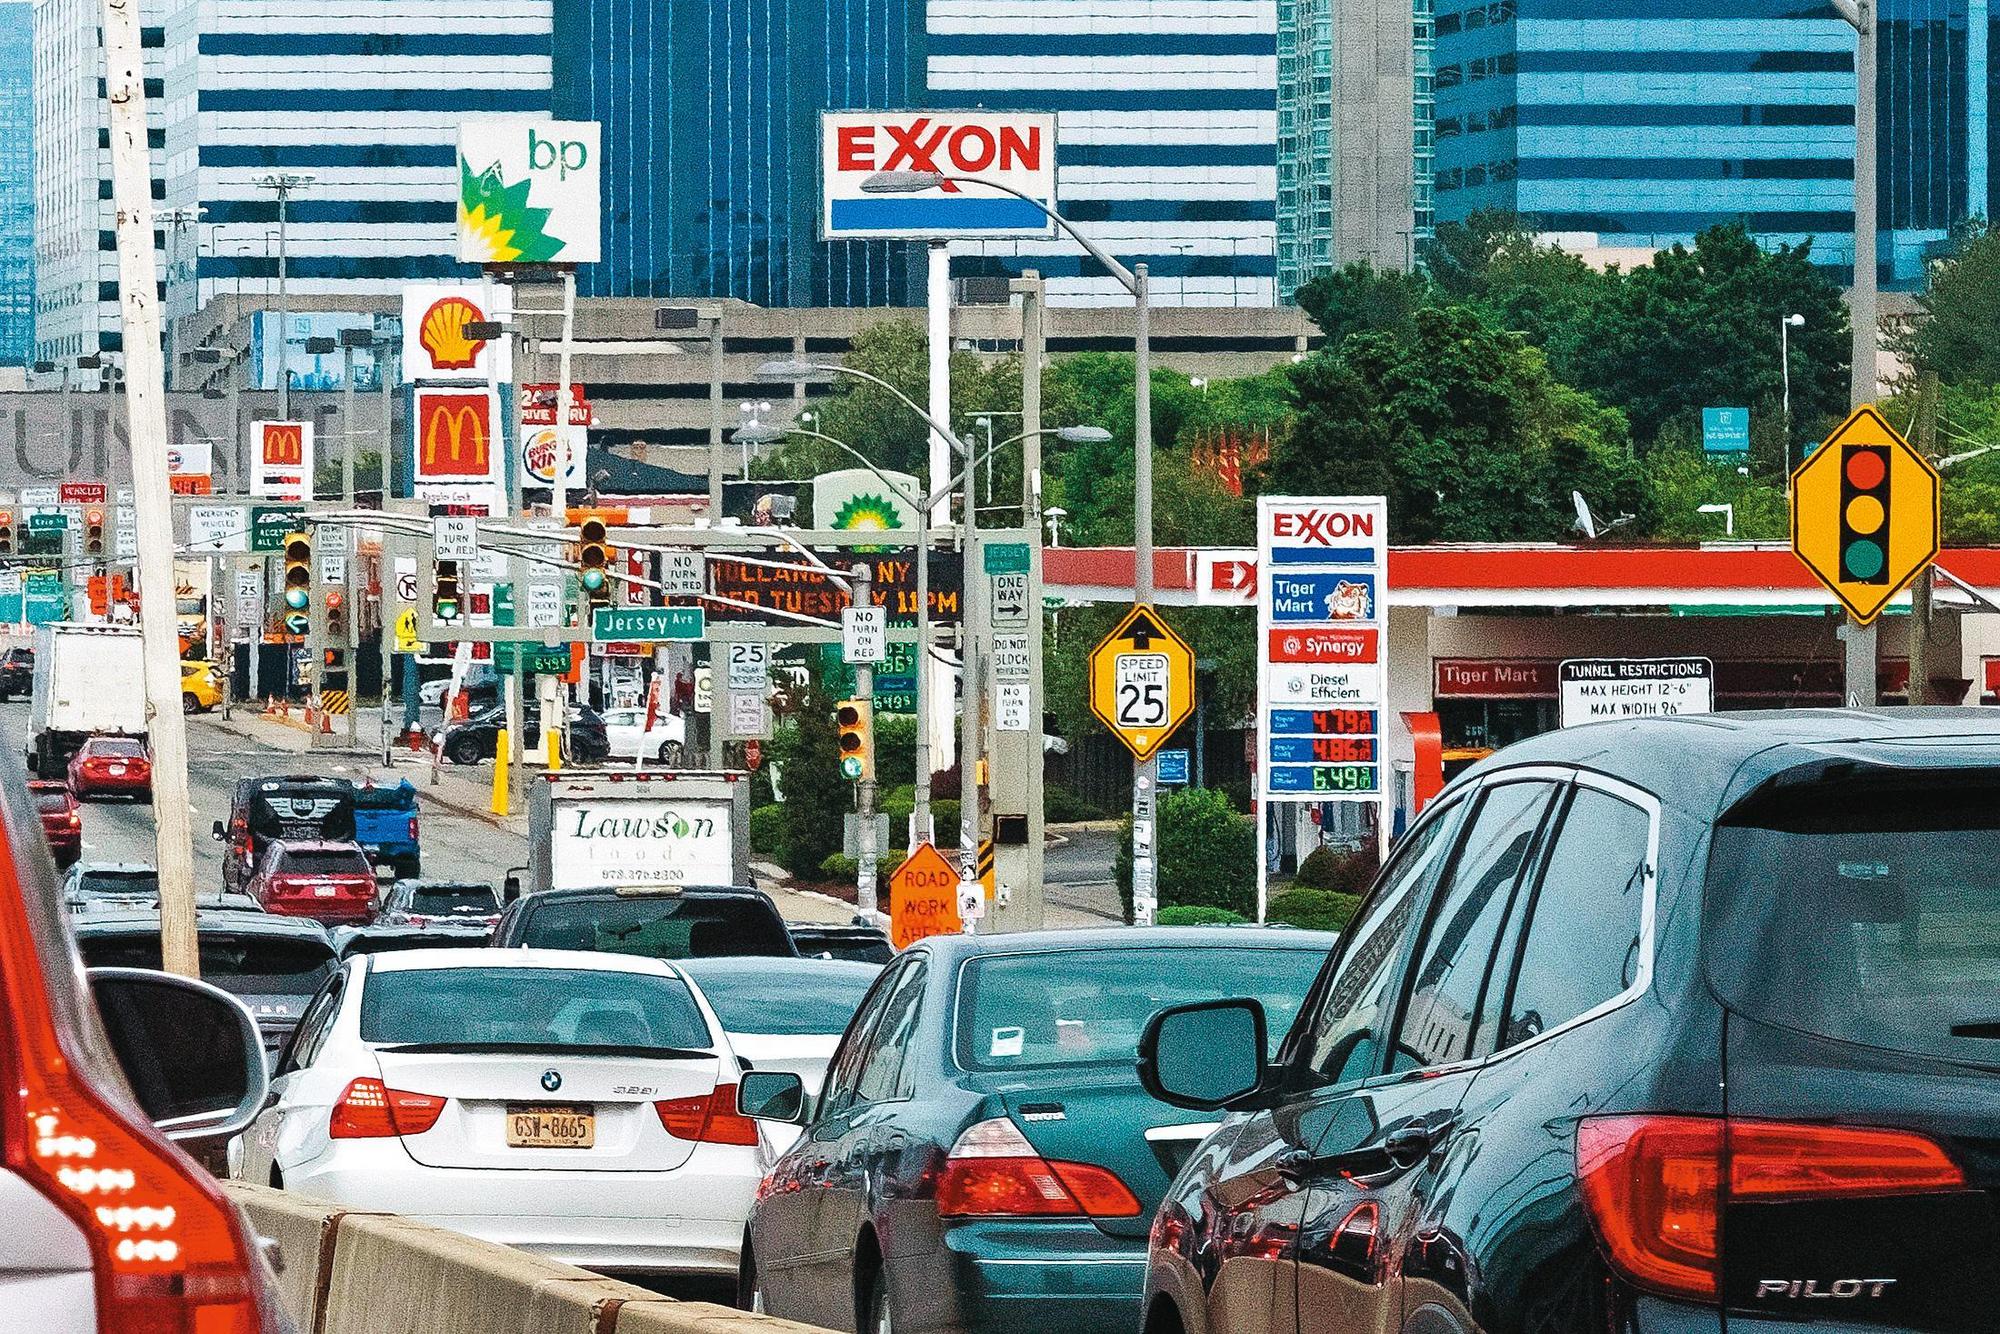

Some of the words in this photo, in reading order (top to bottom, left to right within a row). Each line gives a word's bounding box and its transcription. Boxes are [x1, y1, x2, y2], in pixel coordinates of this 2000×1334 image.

[528, 128, 588, 182] bp
[837, 118, 1041, 193] EXXON
[448, 522, 464, 531] NO
[1273, 509, 1374, 546] EXXON
[443, 535, 470, 544] TURN
[437, 546, 451, 555] ON
[455, 546, 475, 555] RED
[673, 557, 692, 567] NO
[671, 569, 697, 579] TURN
[877, 561, 911, 584] NY
[664, 581, 679, 590] ON
[682, 581, 702, 590] RED
[997, 577, 1024, 588] ONE
[1275, 580, 1316, 597] Tiger
[241, 585, 258, 596] 25
[997, 590, 1024, 601] WAY
[770, 590, 887, 614] TUESDY
[1275, 599, 1314, 613] Mart
[855, 612, 873, 622] NO
[603, 613, 668, 635] Jersey
[672, 612, 694, 624] Ave
[852, 625, 878, 633] TURN
[857, 636, 872, 645] ON
[995, 639, 1008, 649] DO
[1009, 639, 1028, 649] NOT
[854, 648, 875, 657] RED
[1305, 637, 1365, 657] Synergy
[732, 645, 764, 663] 25
[1120, 659, 1164, 670] SPEED
[1568, 665, 1616, 678] TUNNEL
[1619, 663, 1703, 676] RESTRICTIONS
[1125, 672, 1159, 683] LIMIT
[1310, 674, 1349, 686] Diesel
[1445, 666, 1489, 685] Tiger
[1494, 666, 1538, 683] Mart
[1003, 688, 1020, 696] NO
[1311, 687, 1360, 699] Efficient
[1580, 685, 1607, 696] MAX
[1611, 684, 1652, 695] HEIGHT
[1120, 684, 1164, 723] 25
[1590, 703, 1616, 715] MAX
[1621, 702, 1656, 715] WIDTH
[1313, 738, 1359, 762] 4.86
[1313, 767, 1358, 790] 6.49
[569, 809, 716, 839] Lawson
[904, 871, 950, 887] ROAD
[903, 899, 950, 915] WORK
[1755, 1278, 1898, 1298] PILOT
